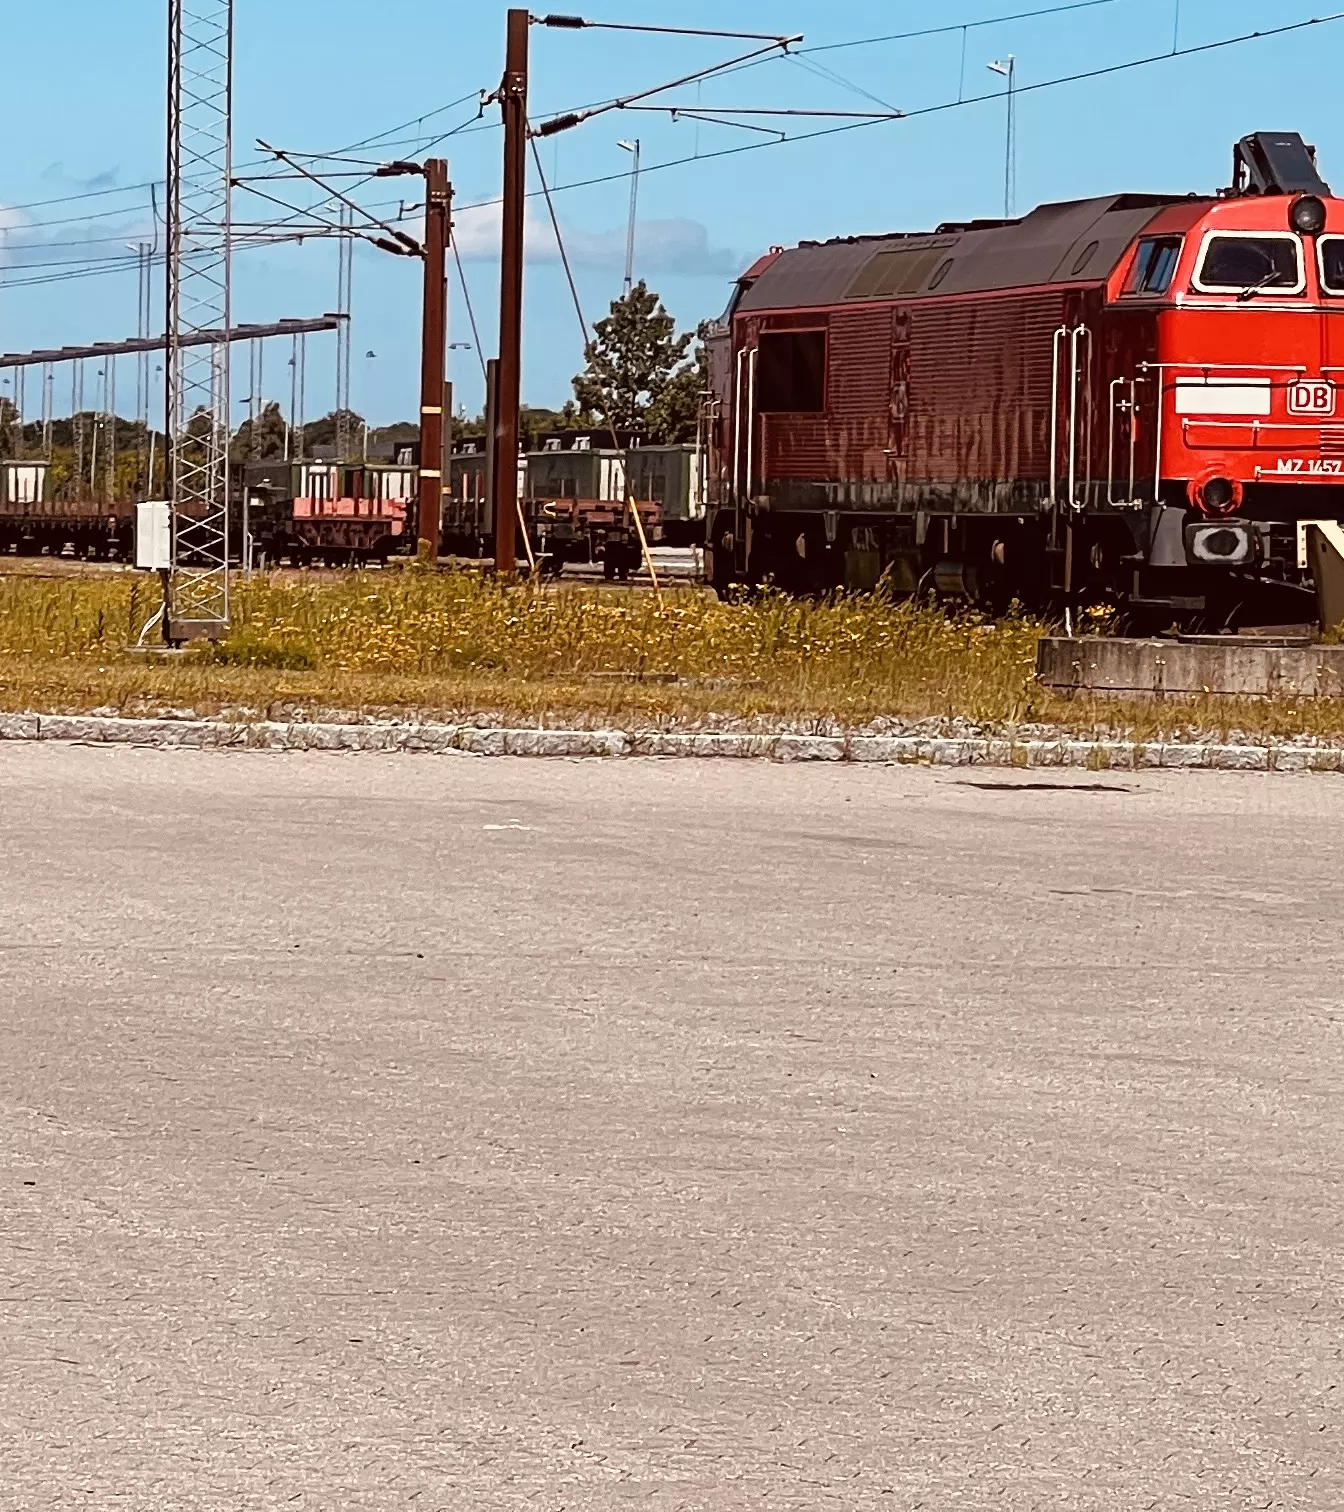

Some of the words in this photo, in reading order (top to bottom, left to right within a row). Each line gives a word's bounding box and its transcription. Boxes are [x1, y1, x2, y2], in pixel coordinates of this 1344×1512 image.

[1295, 386, 1328, 408] DB
[1277, 458, 1304, 474] MZ
[1307, 459, 1343, 474] 1457
